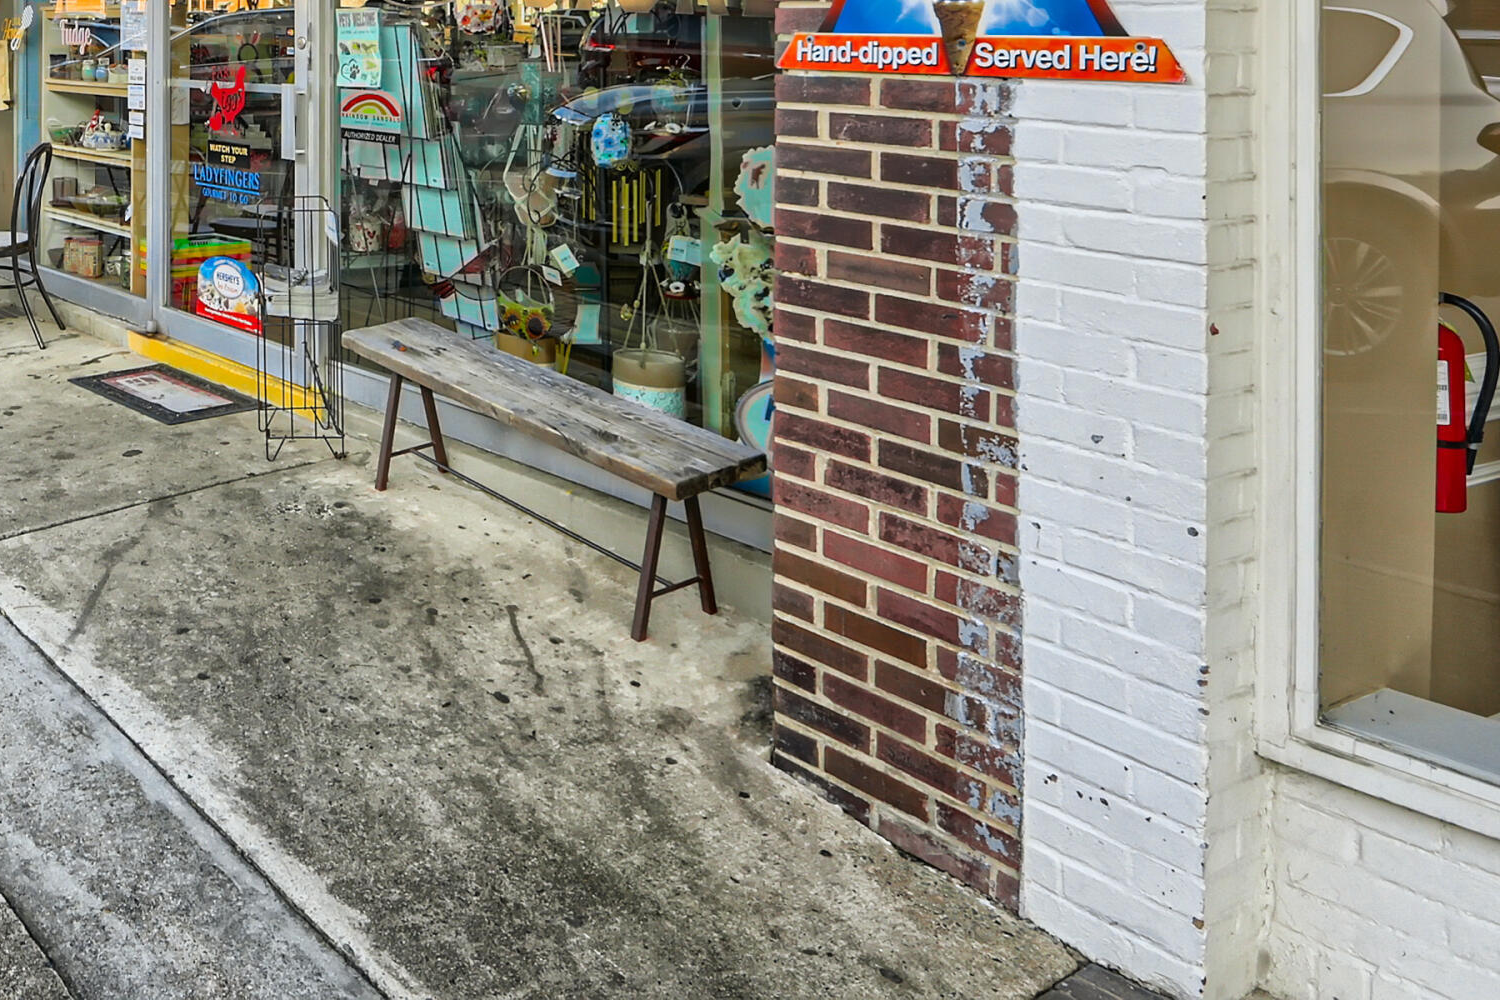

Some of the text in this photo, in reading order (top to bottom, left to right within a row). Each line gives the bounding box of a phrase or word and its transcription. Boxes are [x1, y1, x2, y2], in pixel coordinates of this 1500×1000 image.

[338, 13, 352, 28] PETS
[796, 40, 1158, 73] Hand-dipped Served Here!
[343, 130, 396, 143] AUTHORIZED DEALER
[209, 143, 249, 156] WATCH YOUR
[220, 154, 236, 164] STEP
[193, 164, 261, 191] LADYFINGERS
[216, 271, 241, 286] HERSHEY'S
